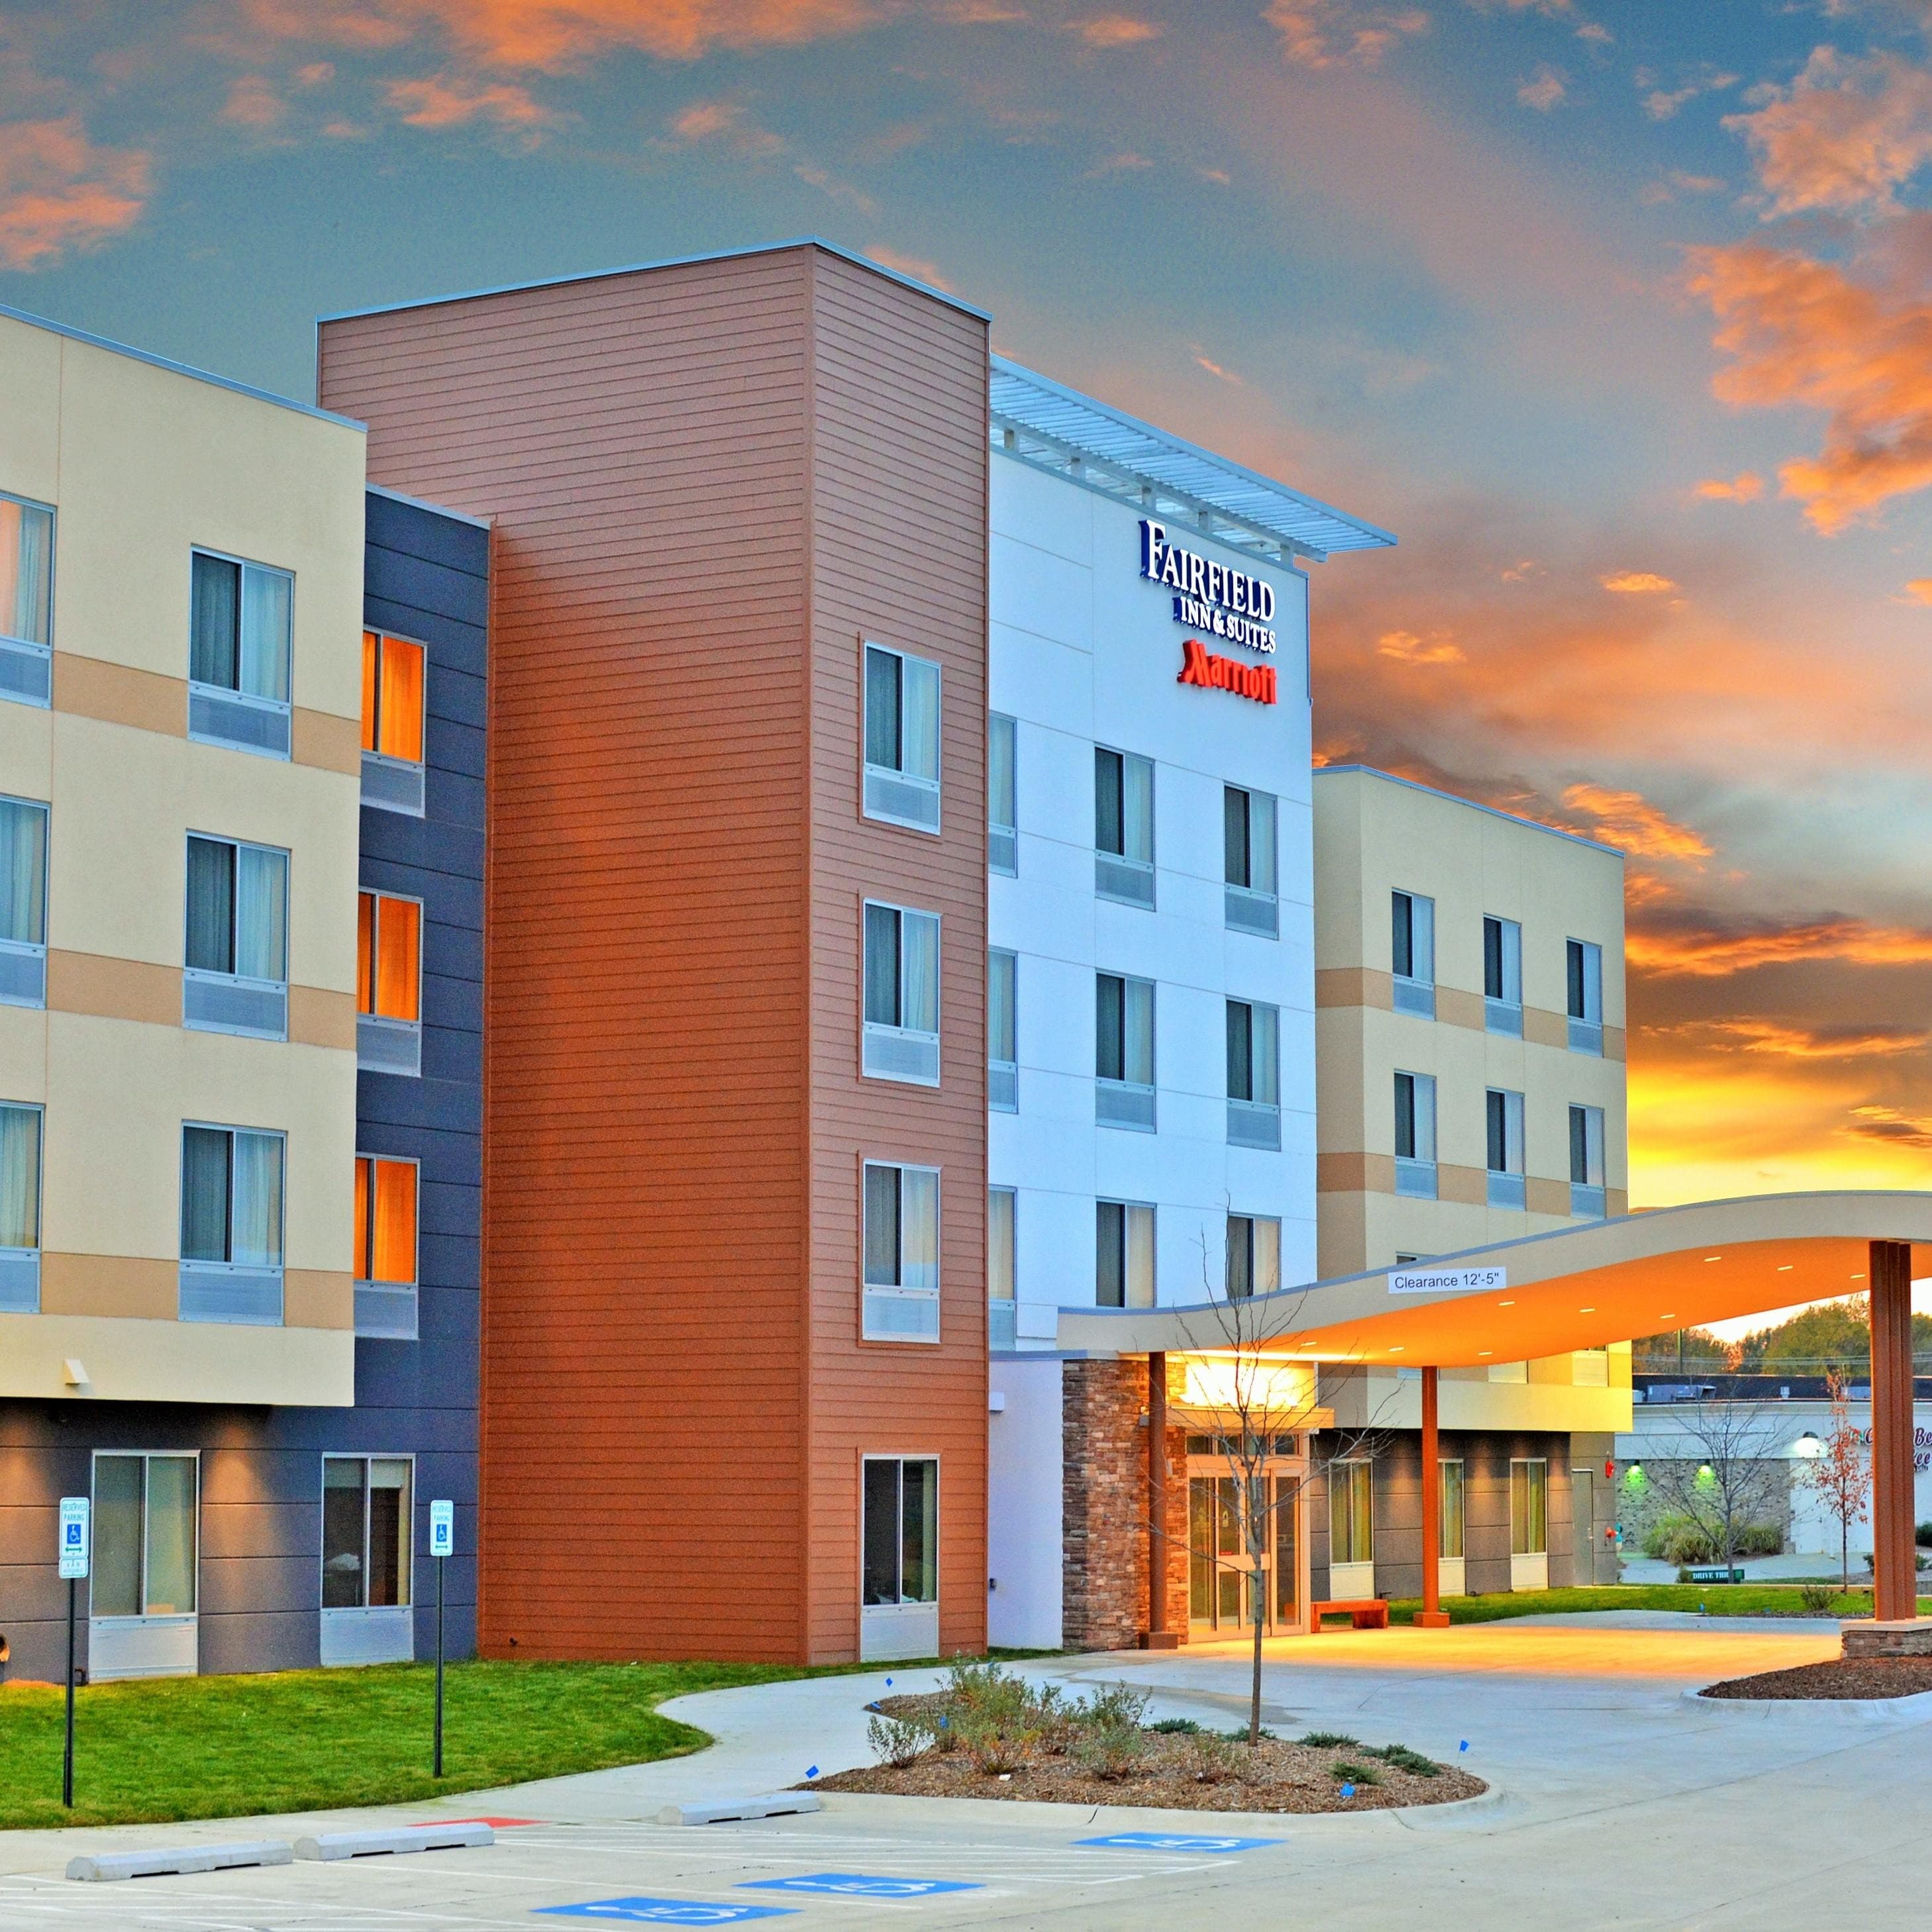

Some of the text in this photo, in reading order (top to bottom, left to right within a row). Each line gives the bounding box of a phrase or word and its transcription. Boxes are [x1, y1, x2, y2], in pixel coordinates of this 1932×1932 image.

[1139, 519, 1275, 622] FAIRFIELD
[1173, 596, 1276, 654] INN & SUITES
[1177, 639, 1277, 705] Marriott
[1395, 1272, 1499, 1288] Clearance 12'-5"
